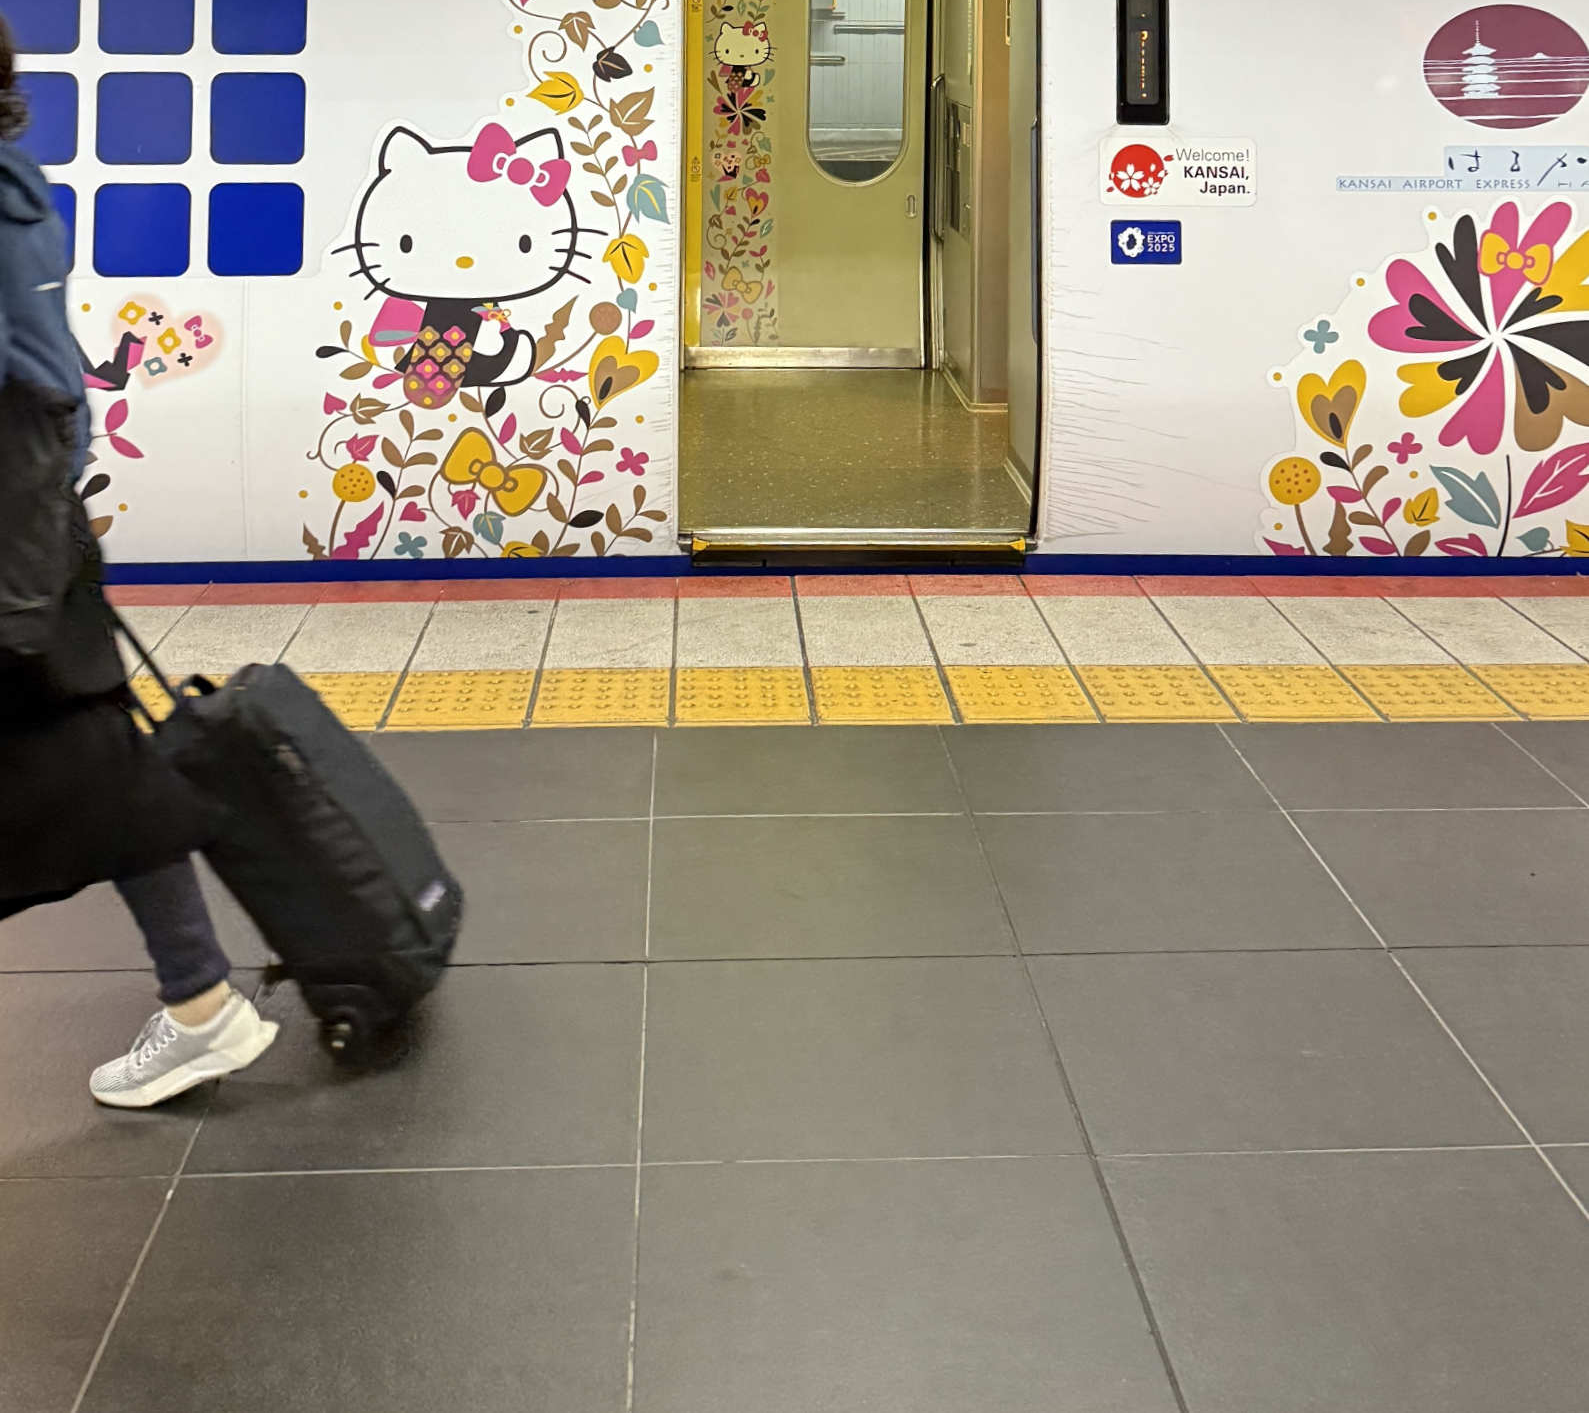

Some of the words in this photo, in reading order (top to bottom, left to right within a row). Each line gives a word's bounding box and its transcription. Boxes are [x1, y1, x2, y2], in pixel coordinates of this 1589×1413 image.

[1175, 147, 1250, 162] Welcome!
[1183, 166, 1250, 180] KANSAI,
[1199, 181, 1251, 197] Japan.
[1339, 179, 1392, 189] KANSAI
[1402, 179, 1463, 189] AIRPORT
[1476, 179, 1531, 189] EXPRESS
[1147, 234, 1176, 244] EXPO
[1147, 243, 1176, 252] 2025
